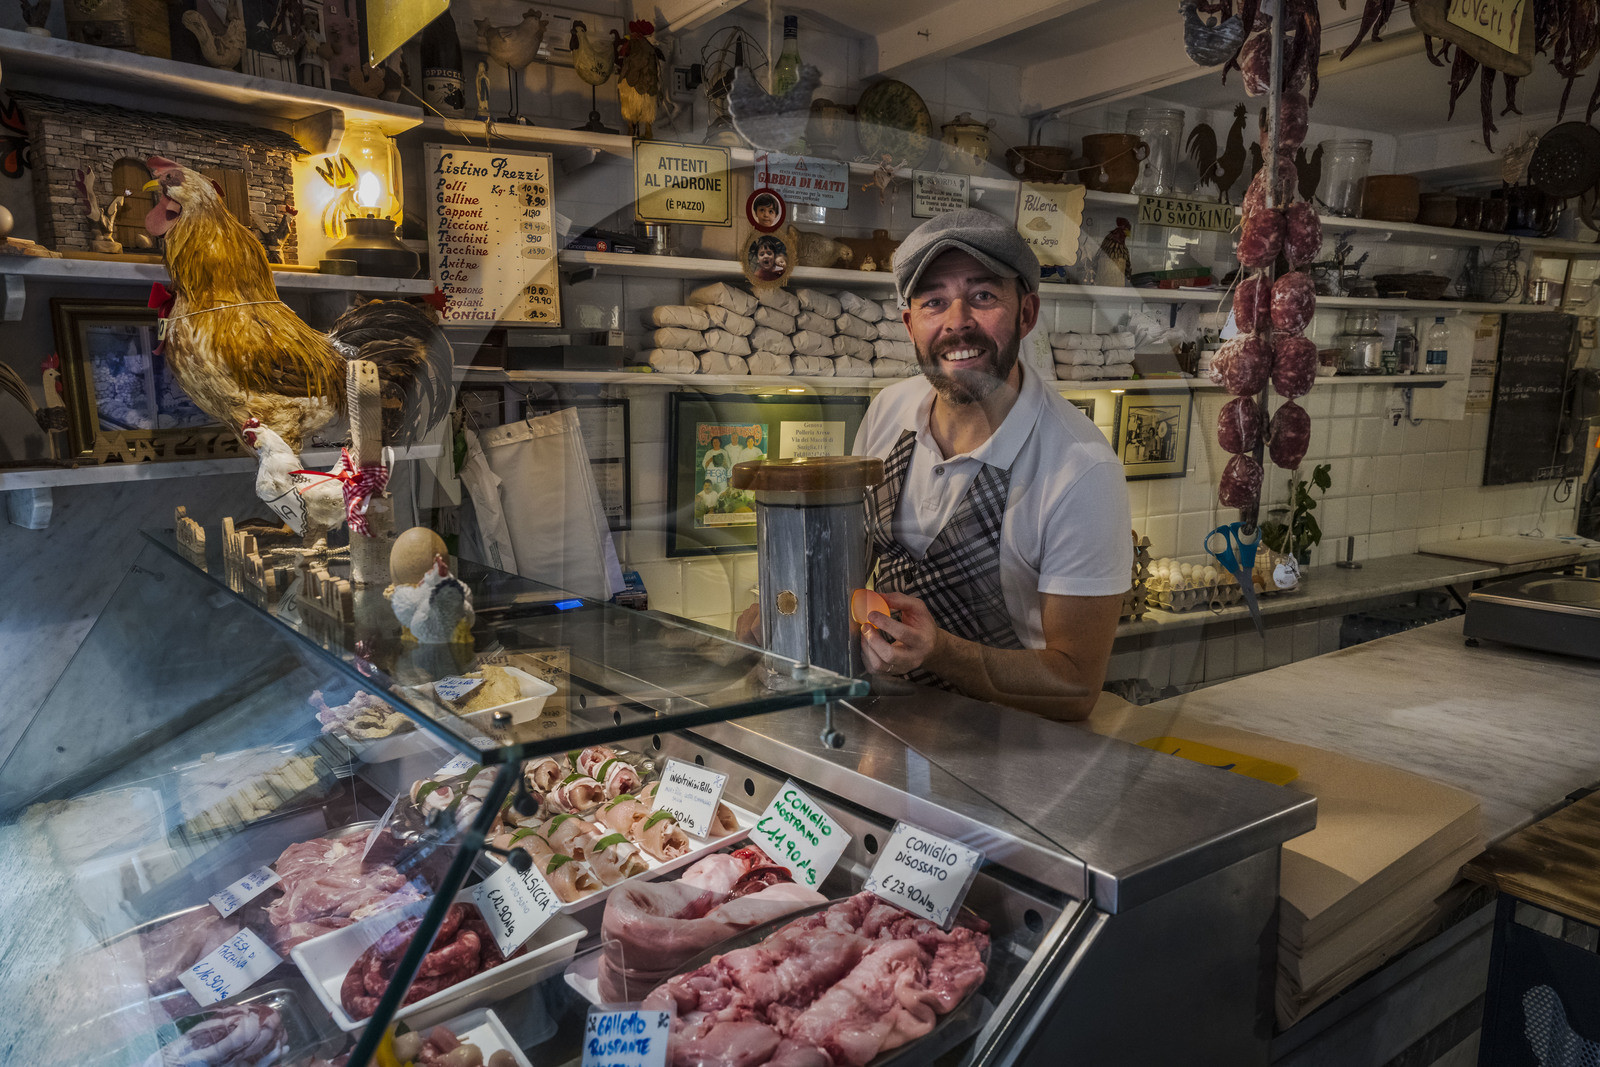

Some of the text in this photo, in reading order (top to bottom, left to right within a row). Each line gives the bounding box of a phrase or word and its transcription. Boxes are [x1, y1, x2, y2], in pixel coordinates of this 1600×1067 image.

[434, 153, 544, 181] Listino Prezzi
[658, 156, 708, 173] ATTENTI
[436, 178, 467, 191] Polli
[644, 173, 722, 192] AL PADRONE
[758, 172, 846, 193] GABBIA DI MATTI
[437, 192, 480, 205] Galline
[1023, 194, 1058, 212] Polleria
[1146, 198, 1202, 212] PLEASE
[436, 205, 483, 219] Capponi
[676, 200, 705, 213] PAZZO)
[1142, 205, 1232, 229] NO SMOKING
[438, 217, 489, 232] Piccioni
[438, 230, 488, 244] Tacchini
[438, 243, 488, 256] Tacchine
[439, 256, 479, 270] Anitre
[440, 270, 468, 282] Oche
[442, 282, 484, 295] Faraone
[445, 295, 552, 309] Fagiani 29.90
[773, 800, 819, 847] NOSTRANO
[895, 850, 948, 881] DISOSSATO
[588, 1037, 652, 1057] RUSPANTE
